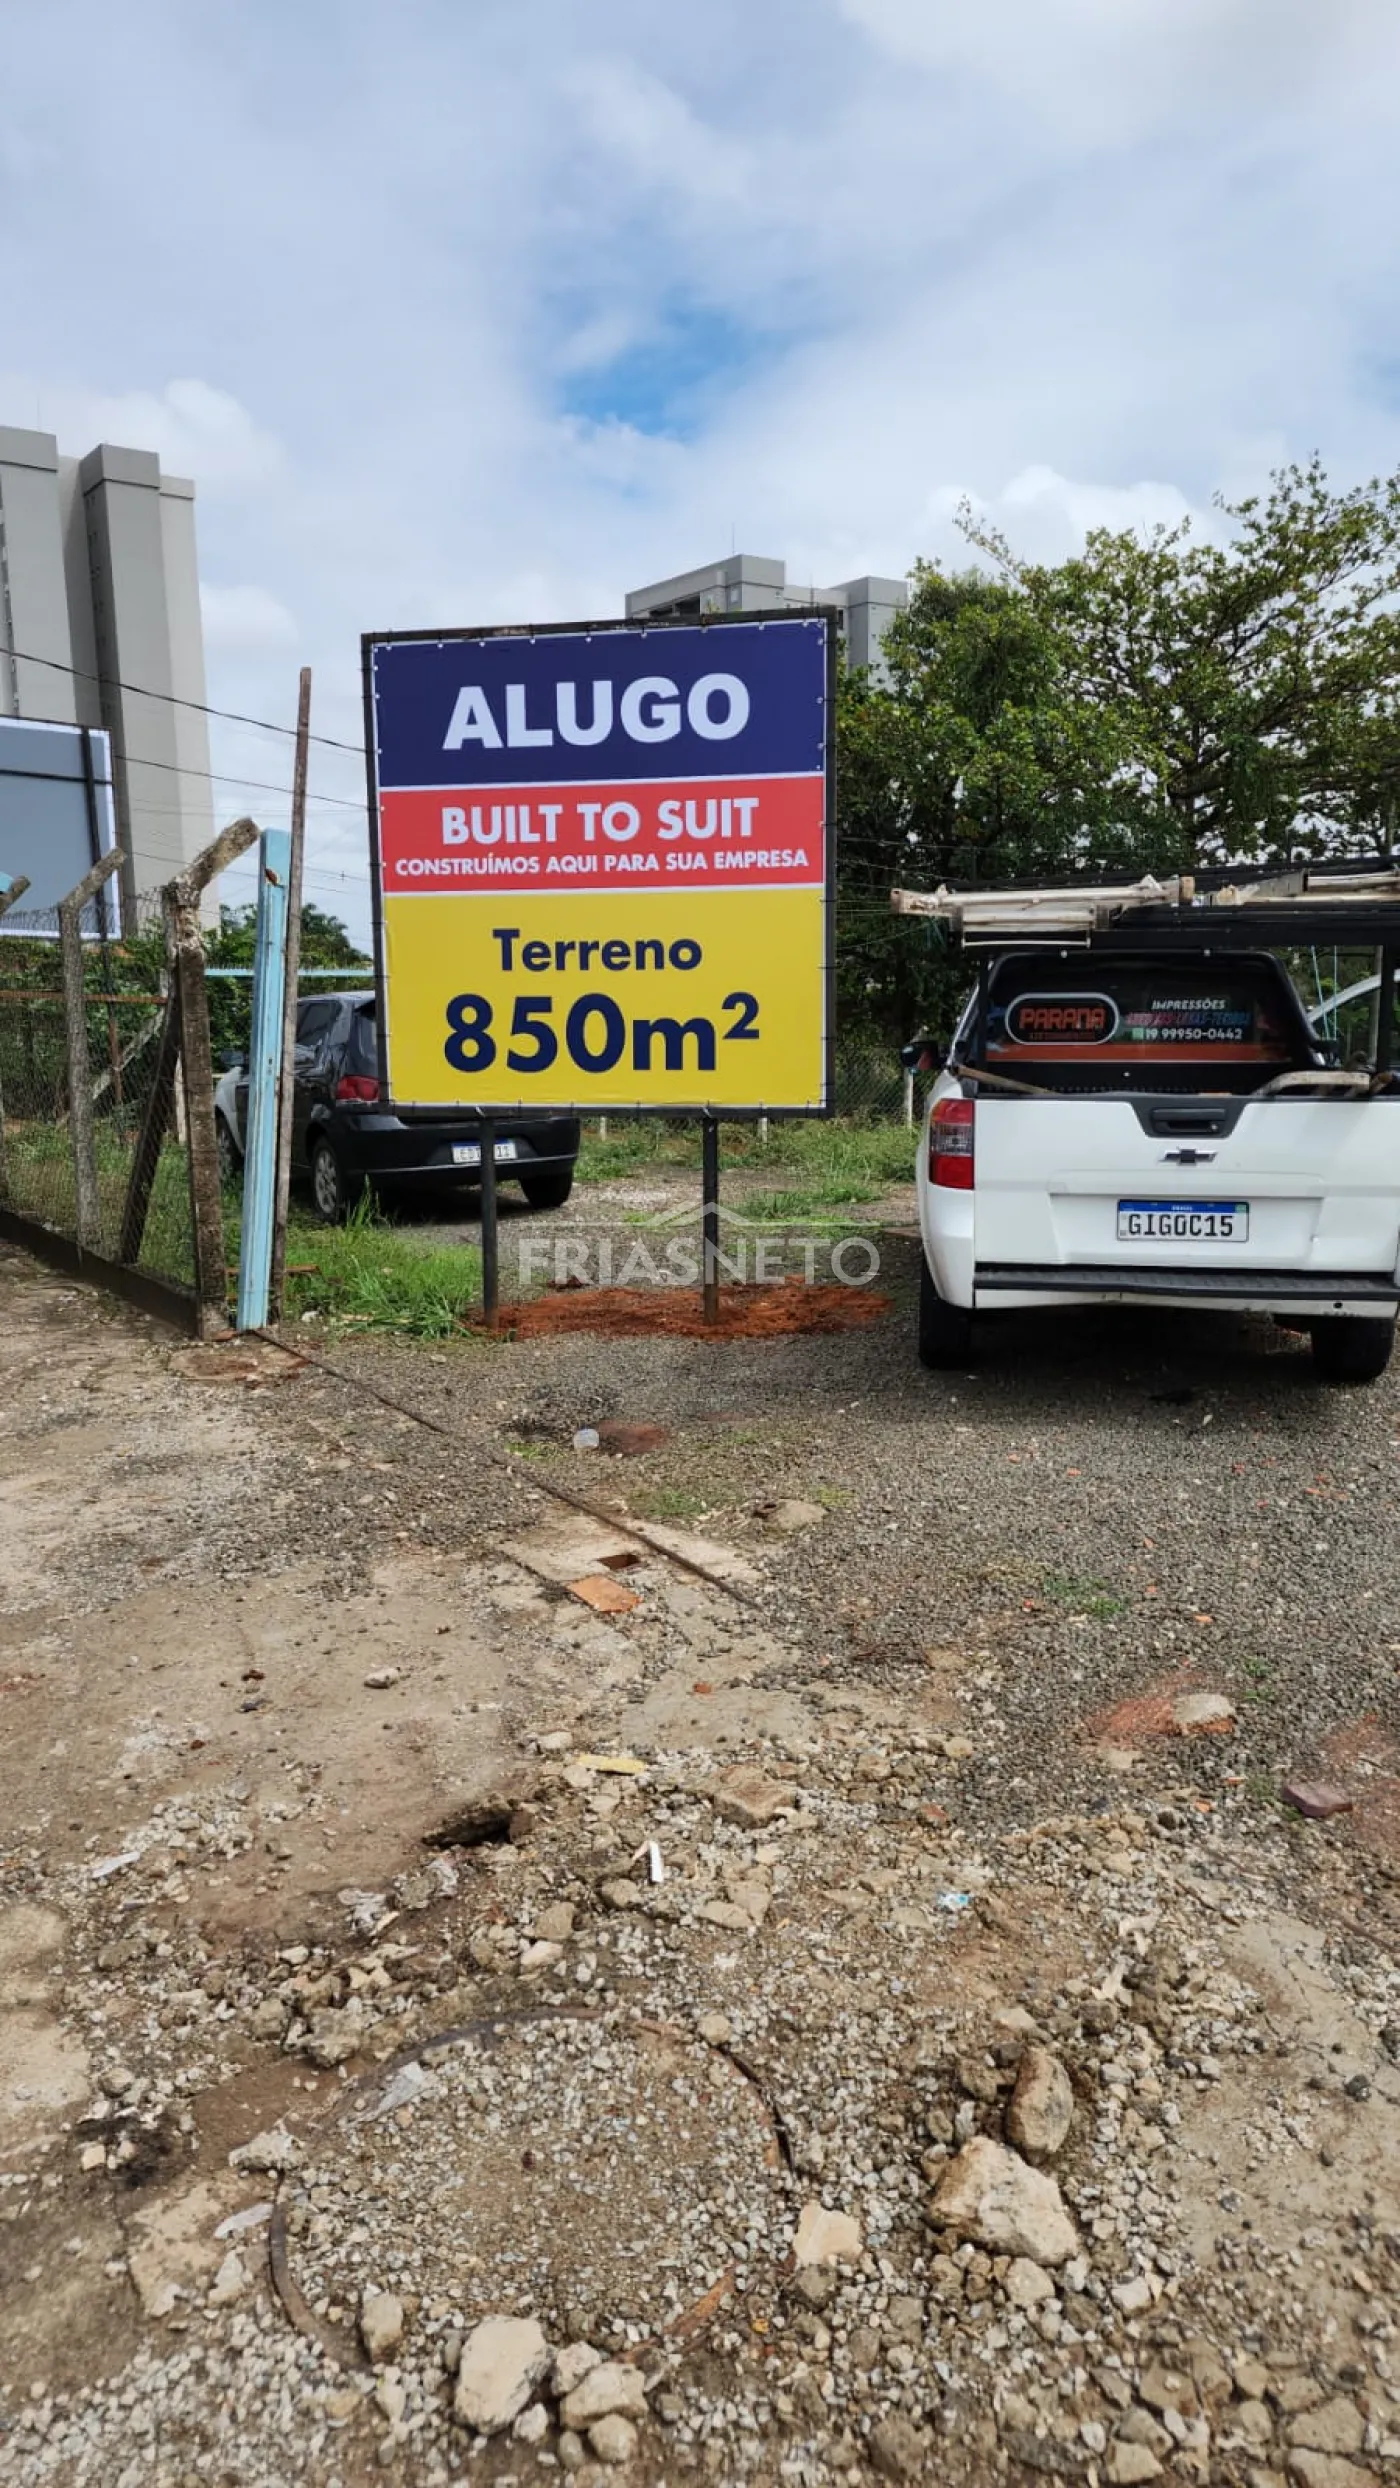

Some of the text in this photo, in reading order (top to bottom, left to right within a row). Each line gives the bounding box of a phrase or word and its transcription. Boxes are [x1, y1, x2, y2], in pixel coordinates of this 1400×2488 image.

[442, 673, 750, 750] ALUGO
[441, 797, 760, 845] BUILT TO SUIT
[395, 848, 809, 876] CONSTRUÍMOS AQUI PARA SUA EMPRESA
[492, 928, 703, 972] Terreno
[1151, 998, 1226, 1010] IMPRESSÕES
[444, 991, 760, 1074] 850m²
